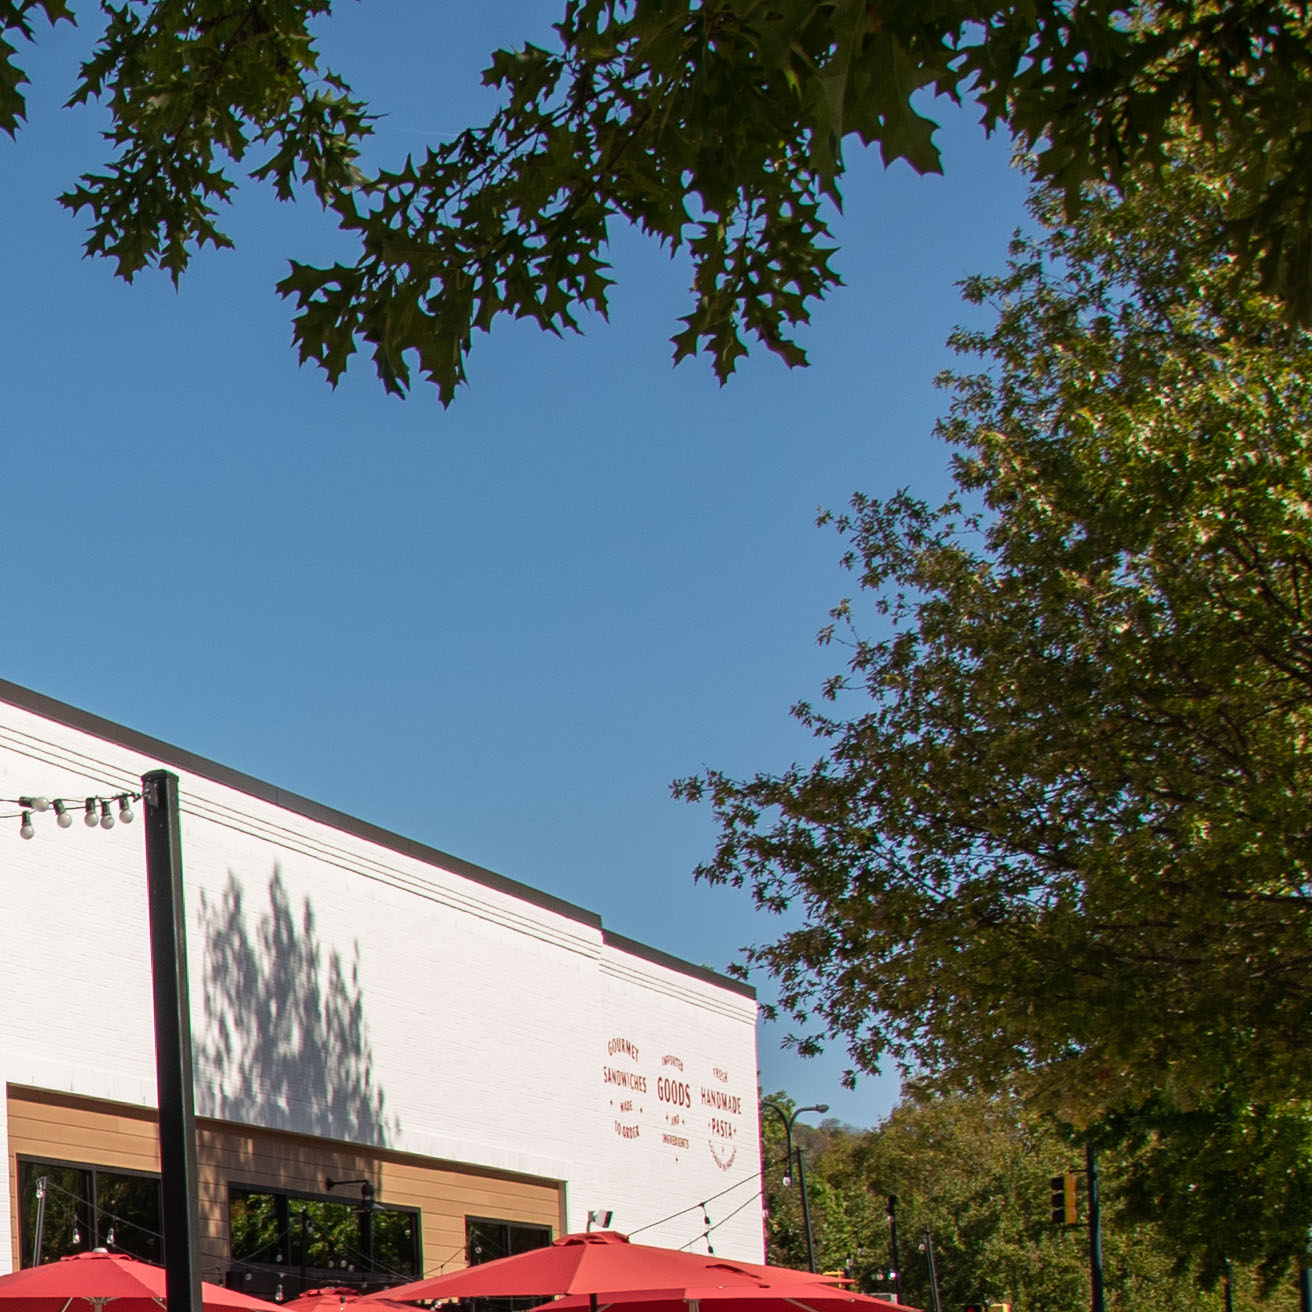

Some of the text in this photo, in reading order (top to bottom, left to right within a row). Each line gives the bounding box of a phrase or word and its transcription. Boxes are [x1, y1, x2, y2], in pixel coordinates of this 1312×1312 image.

[607, 1037, 640, 1063] GOURMET
[603, 1066, 647, 1093] SANDWICHES
[657, 1076, 691, 1109] GOODS
[700, 1086, 742, 1115] HANDMADE
[614, 1120, 622, 1136] TO
[711, 1117, 733, 1140] PASTA
